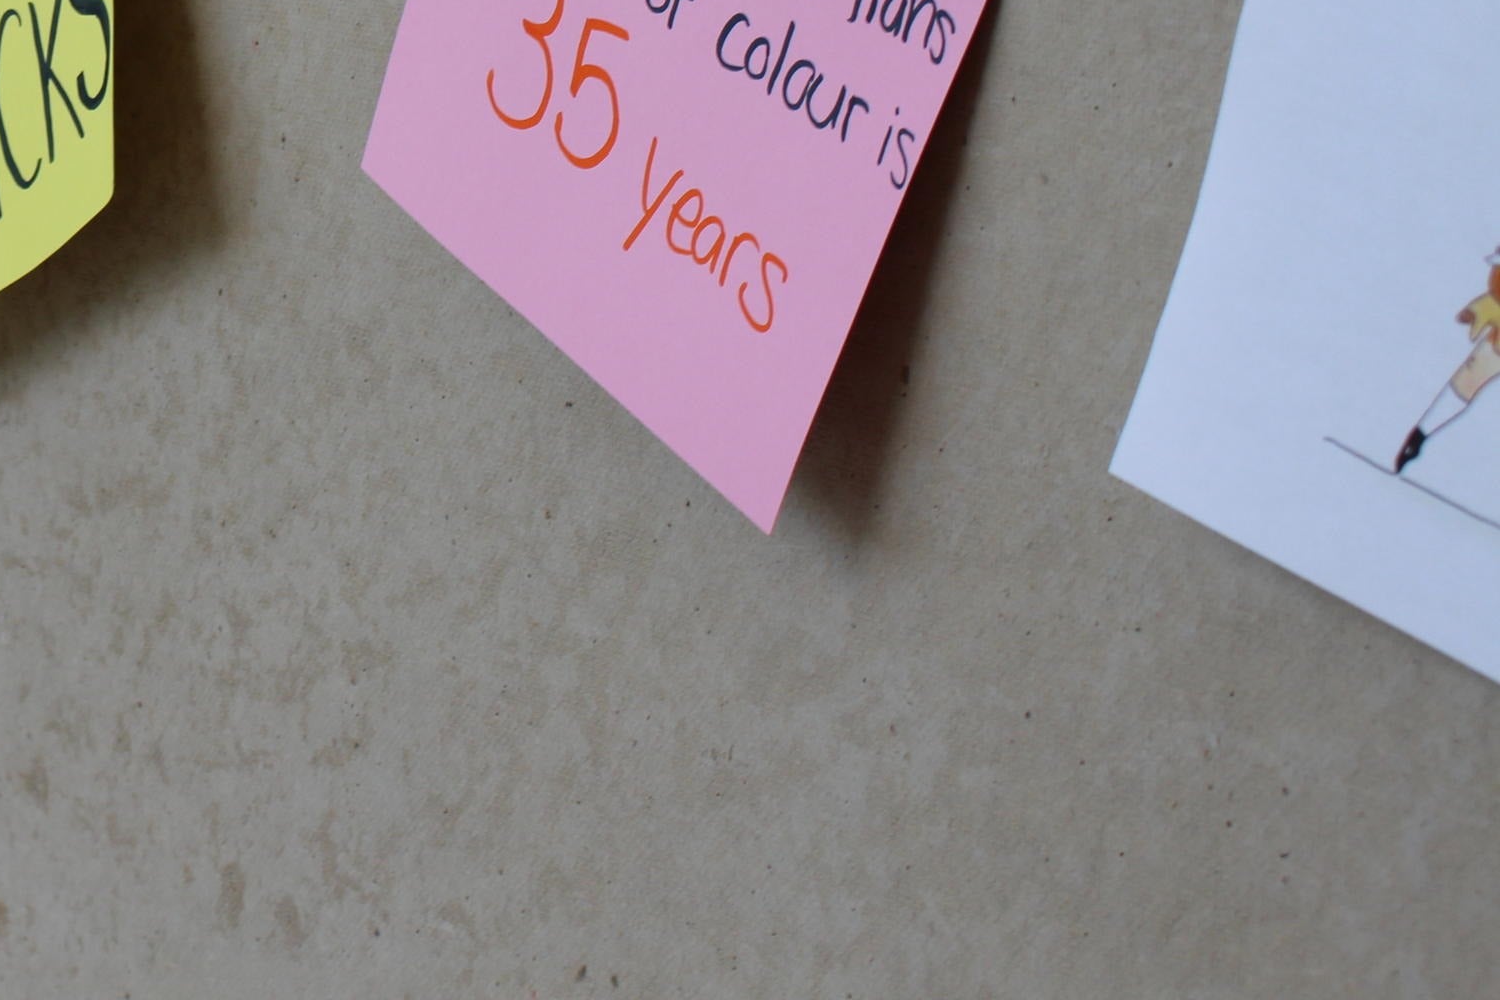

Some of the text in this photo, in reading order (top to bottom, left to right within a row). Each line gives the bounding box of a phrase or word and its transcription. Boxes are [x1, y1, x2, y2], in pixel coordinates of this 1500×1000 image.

[716, 11, 870, 143] colour
[877, 107, 916, 190] is
[622, 136, 788, 333] years
